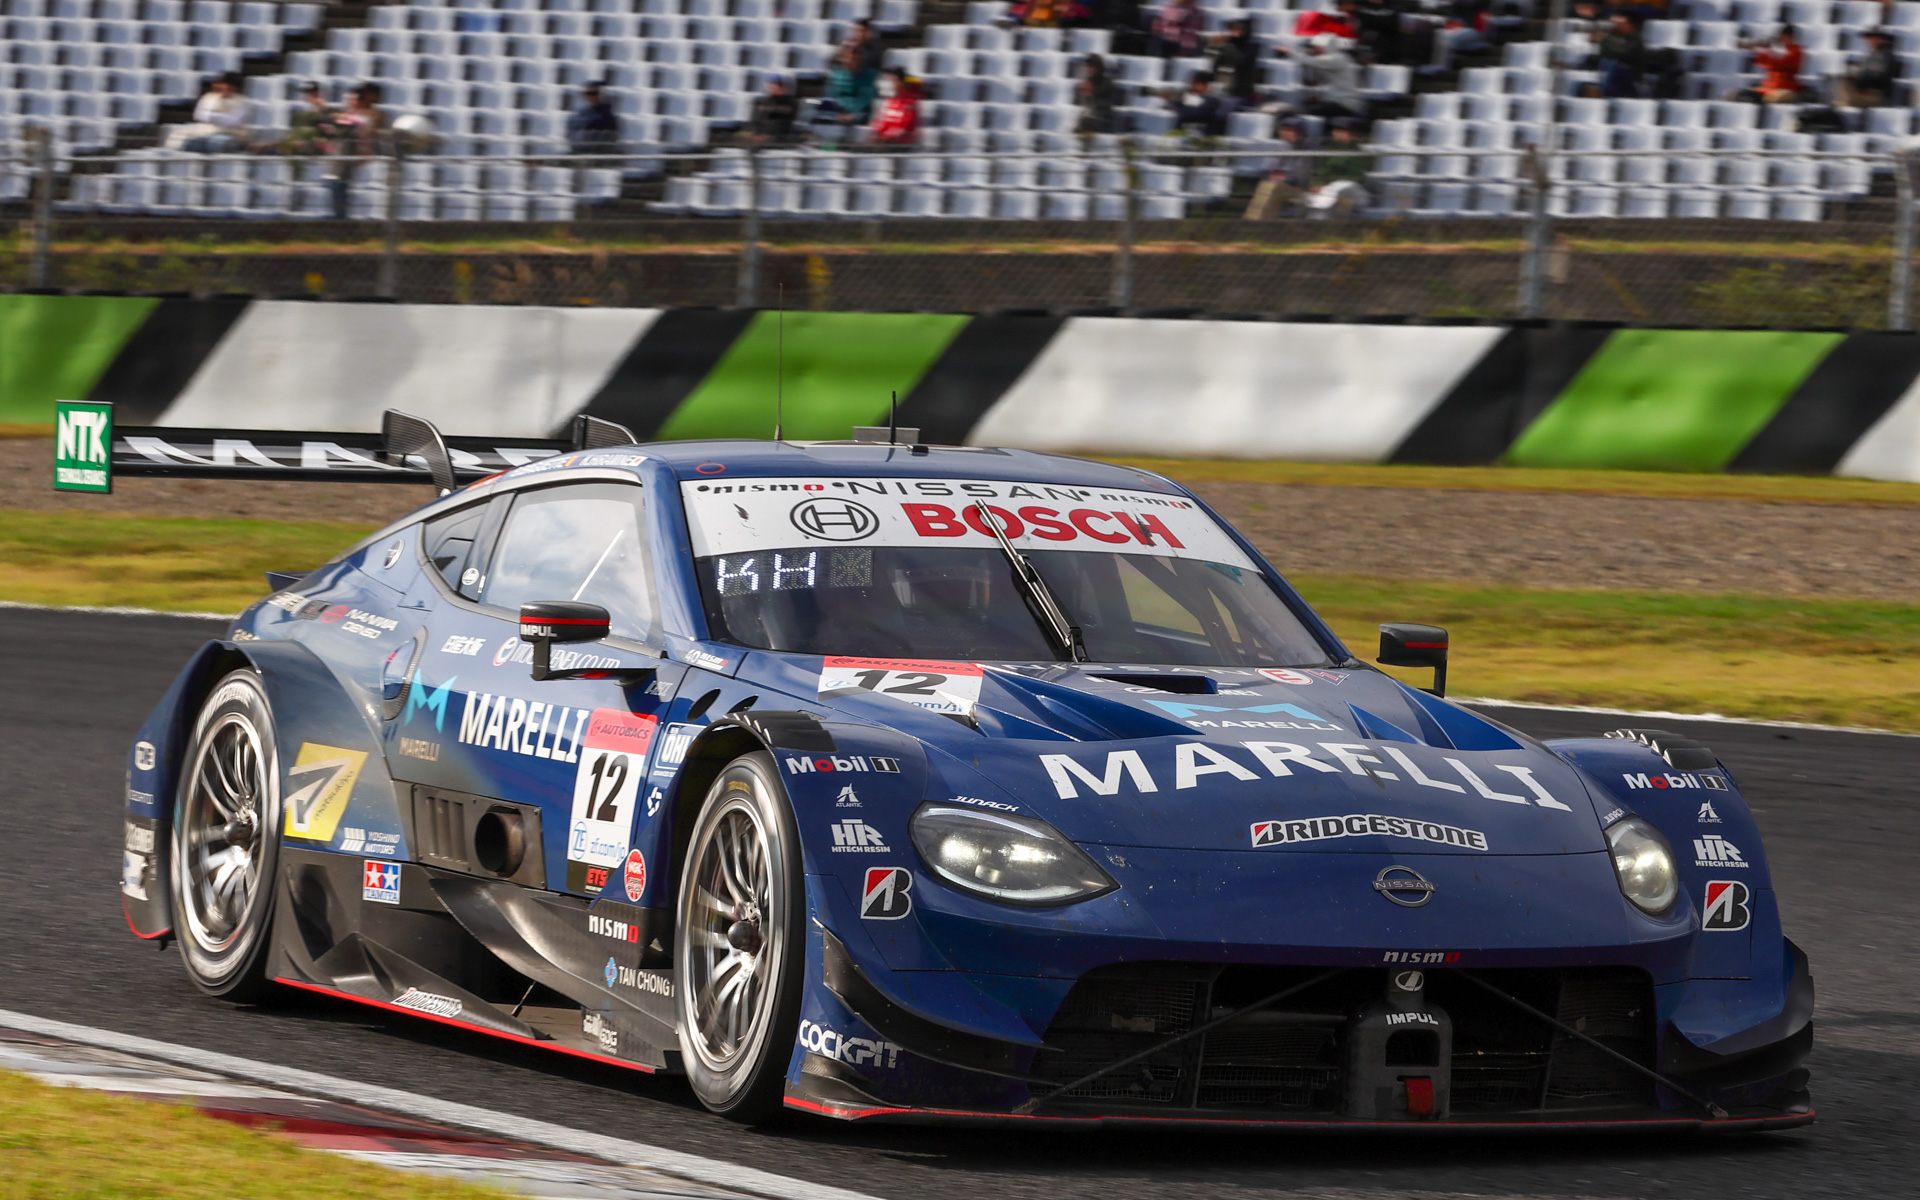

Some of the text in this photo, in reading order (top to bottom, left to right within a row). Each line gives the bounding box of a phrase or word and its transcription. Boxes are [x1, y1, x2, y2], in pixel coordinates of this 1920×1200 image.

[57, 411, 108, 464] NTK
[714, 481, 1187, 509] nismo NISSAN nismo
[900, 502, 1186, 549] BOSCH
[521, 624, 557, 637] IMPUL
[857, 660, 976, 672] AUTOBACS
[854, 669, 947, 695] 12
[458, 690, 590, 764] MARELLI
[601, 723, 650, 740] AUTOBACS
[1185, 719, 1344, 731] MARELLI
[399, 737, 441, 762] MARELLI
[785, 756, 869, 774] Mobil
[586, 752, 629, 822] 12
[1039, 741, 1572, 812] MARELLI
[1622, 773, 1701, 789] Mobil
[948, 796, 1019, 812] JUNACK
[1254, 816, 1486, 849] BRIDGESTONE
[1695, 860, 1725, 868] HITECH
[364, 888, 399, 901] TAMIYA
[1375, 881, 1434, 890] NISSAN
[589, 915, 640, 944] nismo
[1383, 951, 1460, 963] nismo
[618, 966, 637, 988] TAN
[637, 970, 671, 998] CHONG
[1386, 1012, 1439, 1026] IMPUL
[799, 1018, 904, 1069] COCKPIT
